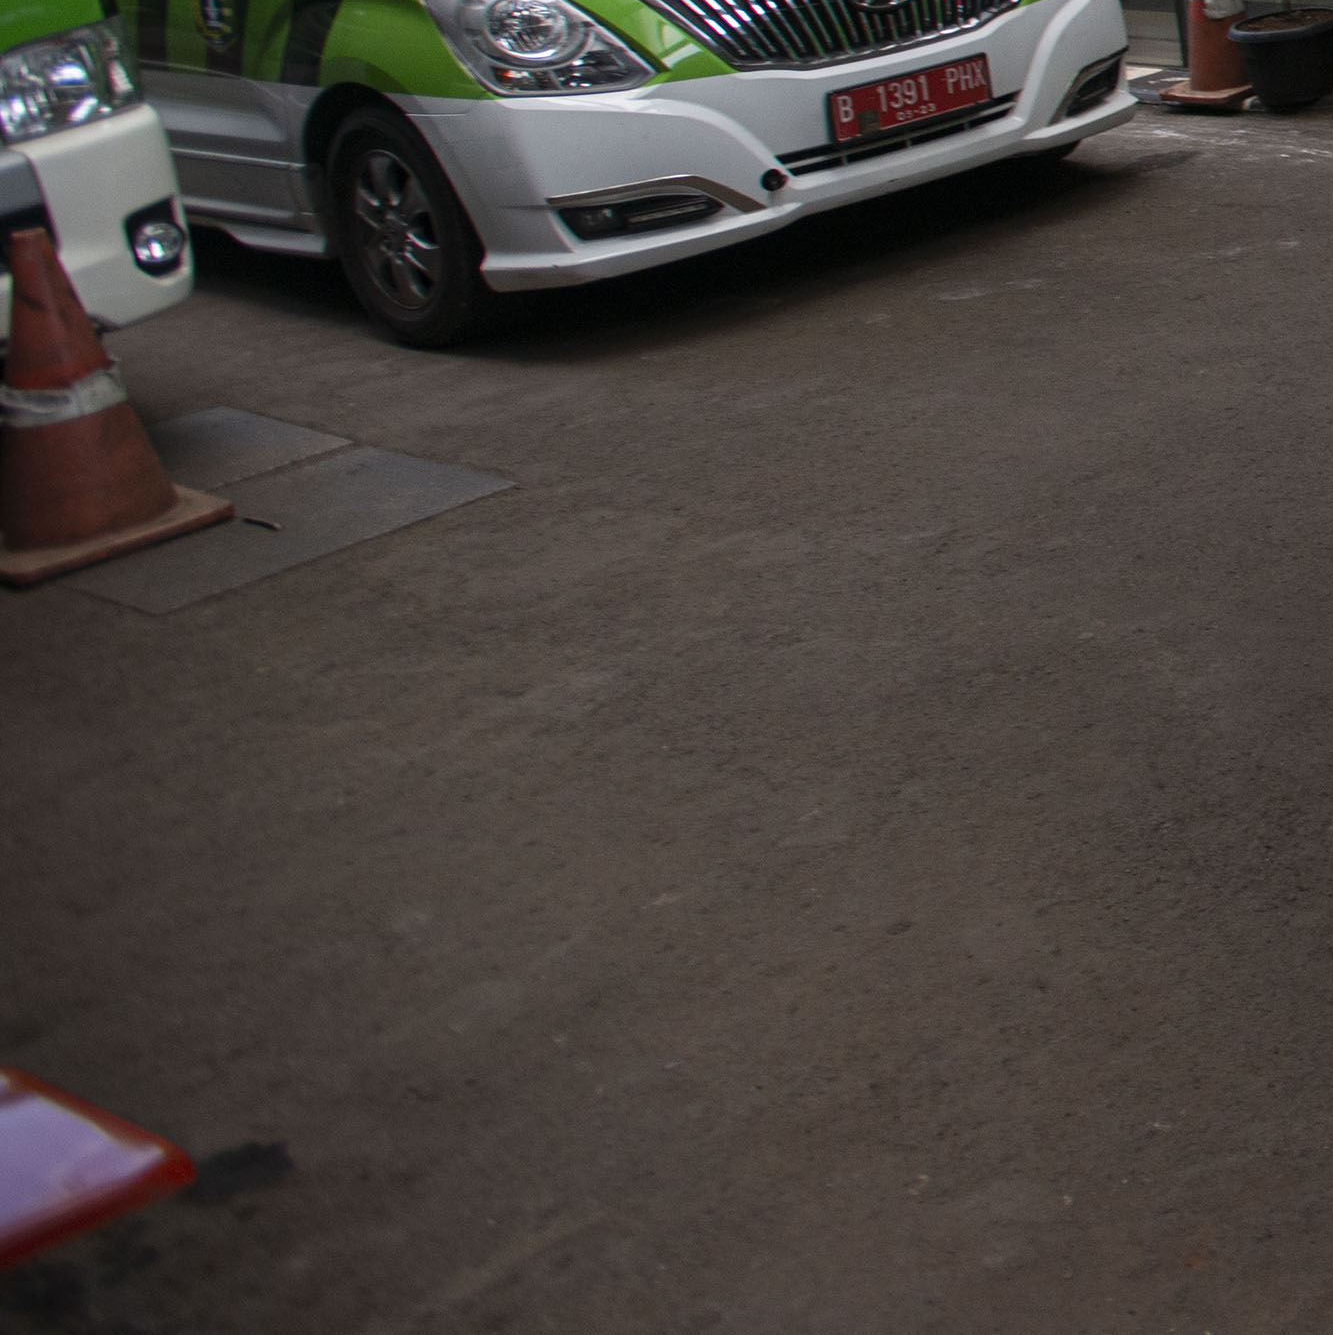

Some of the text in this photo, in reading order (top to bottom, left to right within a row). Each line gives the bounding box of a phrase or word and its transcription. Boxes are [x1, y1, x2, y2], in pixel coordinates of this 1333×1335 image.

[837, 59, 987, 123] B 1391 PHX
